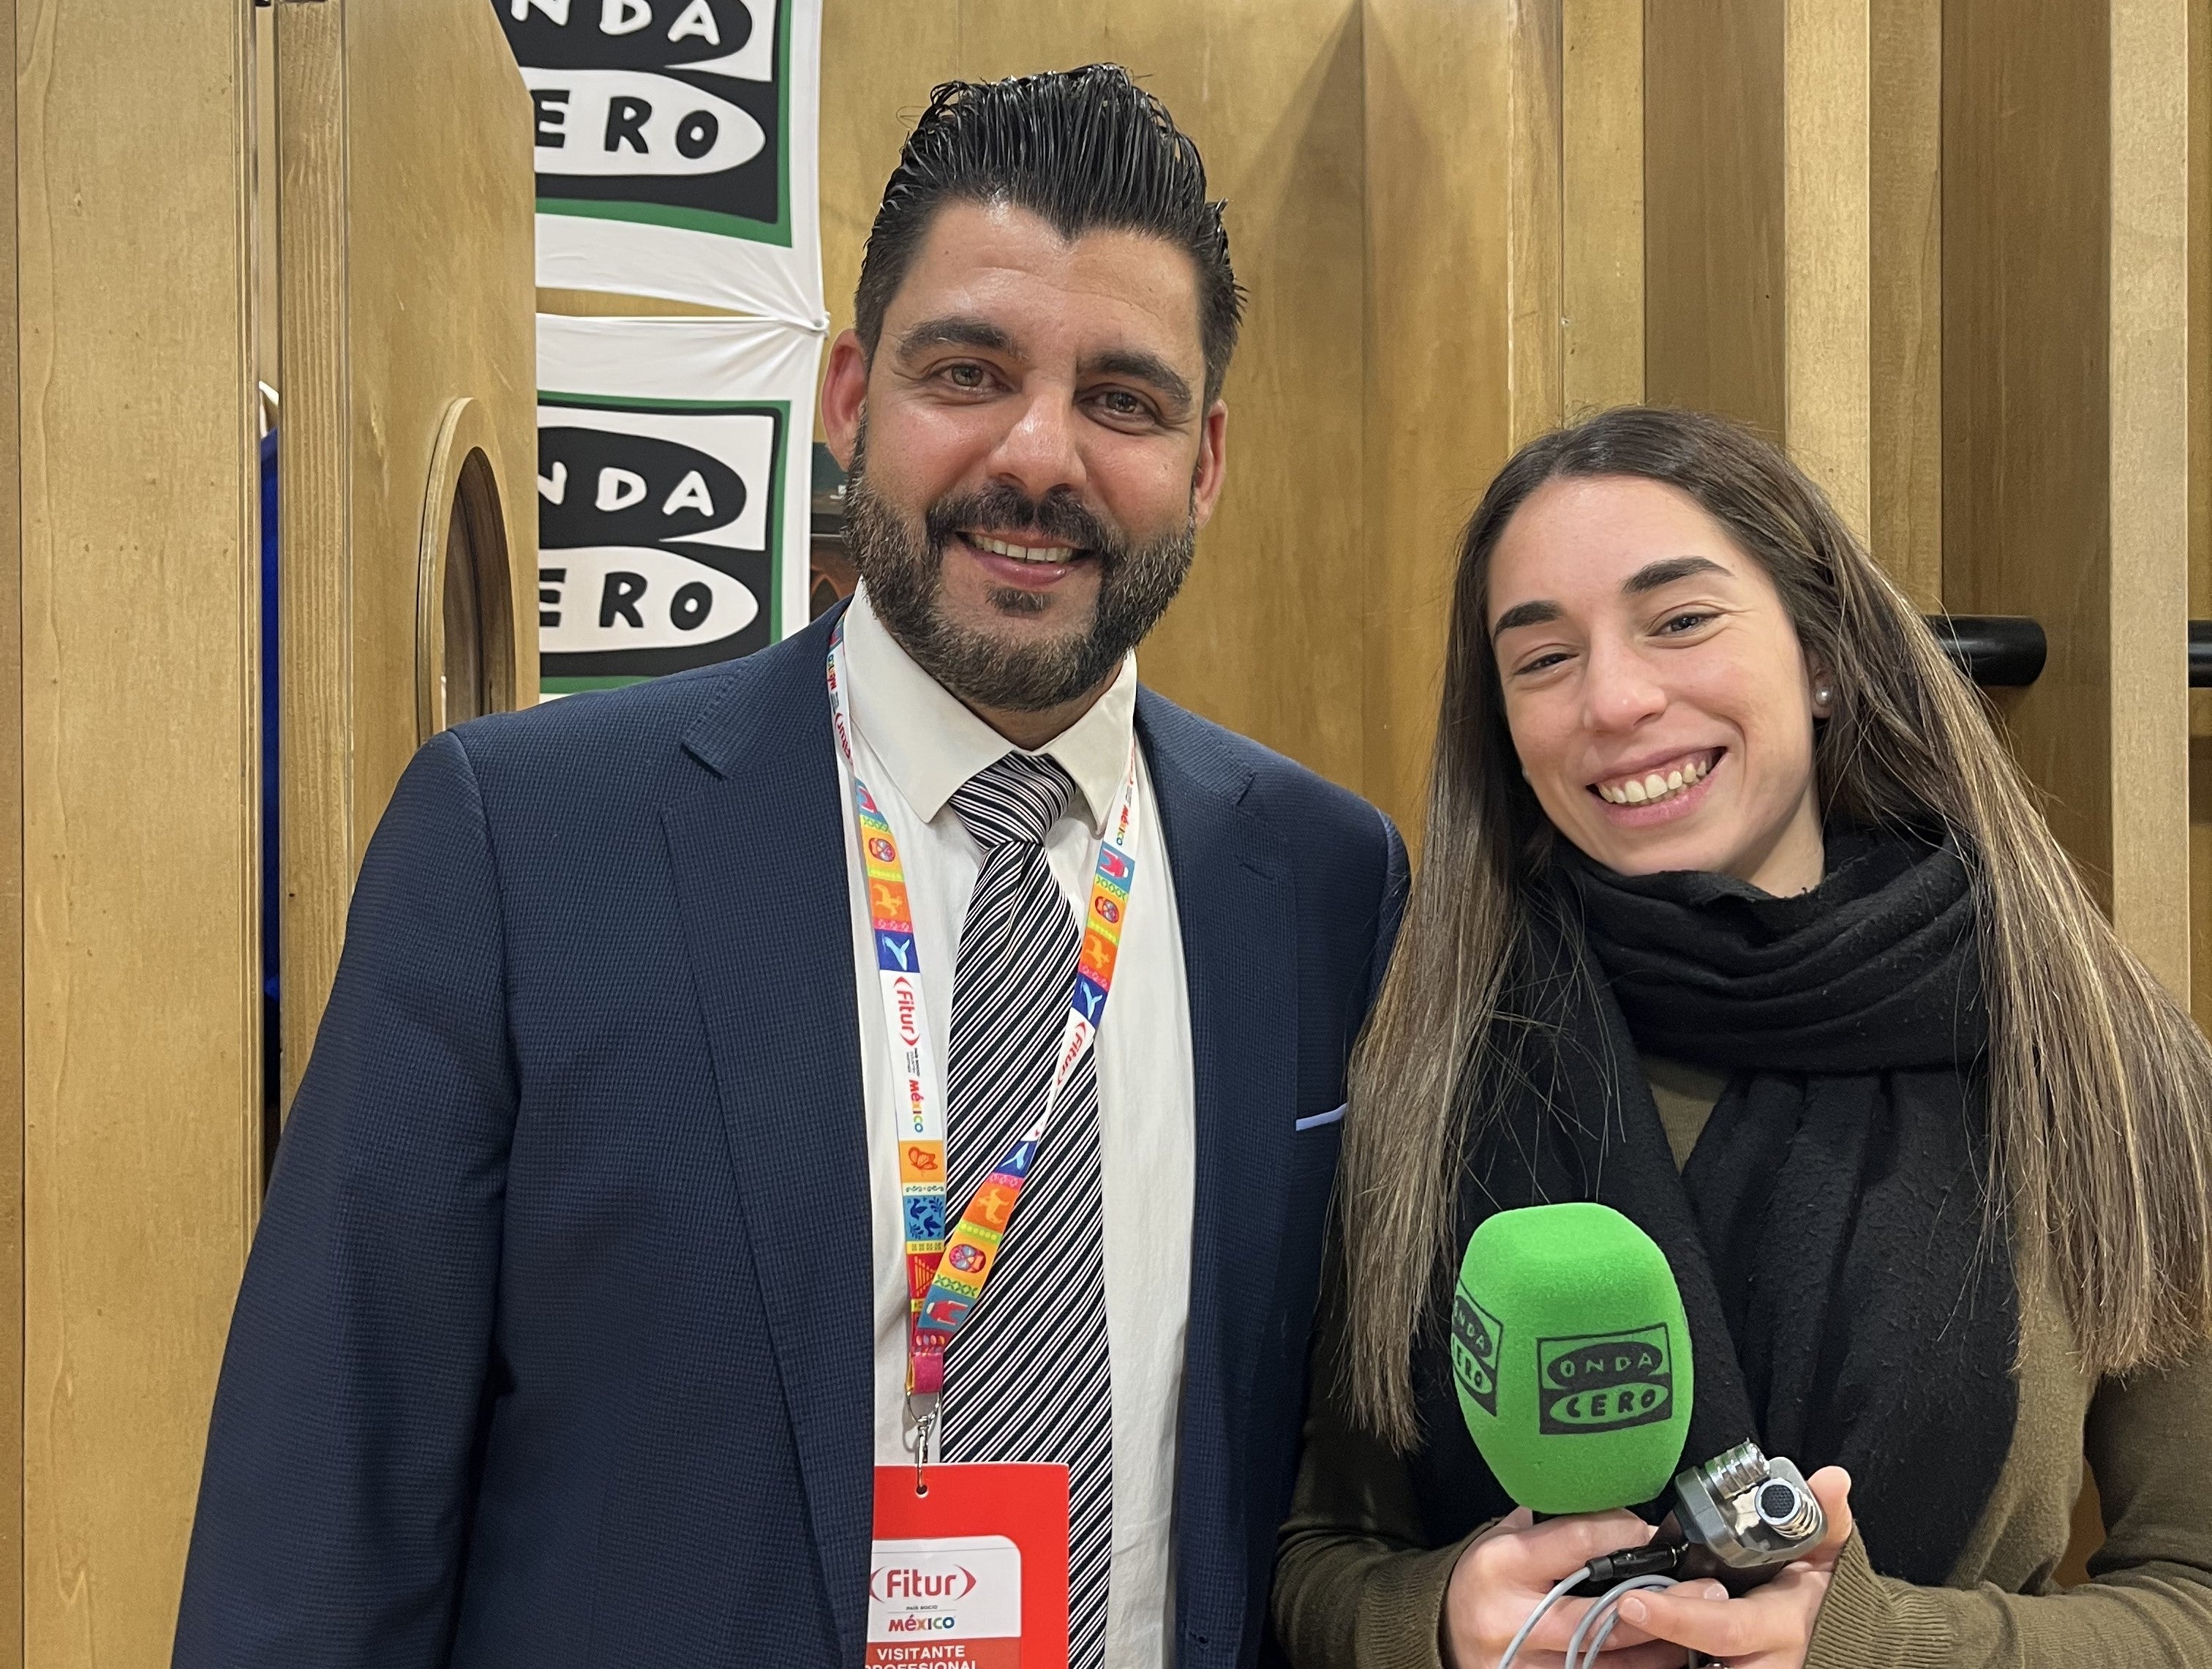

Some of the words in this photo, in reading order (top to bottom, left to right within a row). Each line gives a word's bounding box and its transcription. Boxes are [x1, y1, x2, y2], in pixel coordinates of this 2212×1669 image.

[511, 0, 721, 45] NDA
[531, 89, 719, 159] ERO
[539, 568, 713, 631] ERO
[1452, 1300, 1485, 1351] NDA
[1560, 1353, 1655, 1377] ONDA
[1566, 1389, 1656, 1417] CERO
[877, 1645, 966, 1660] VISITANTE
